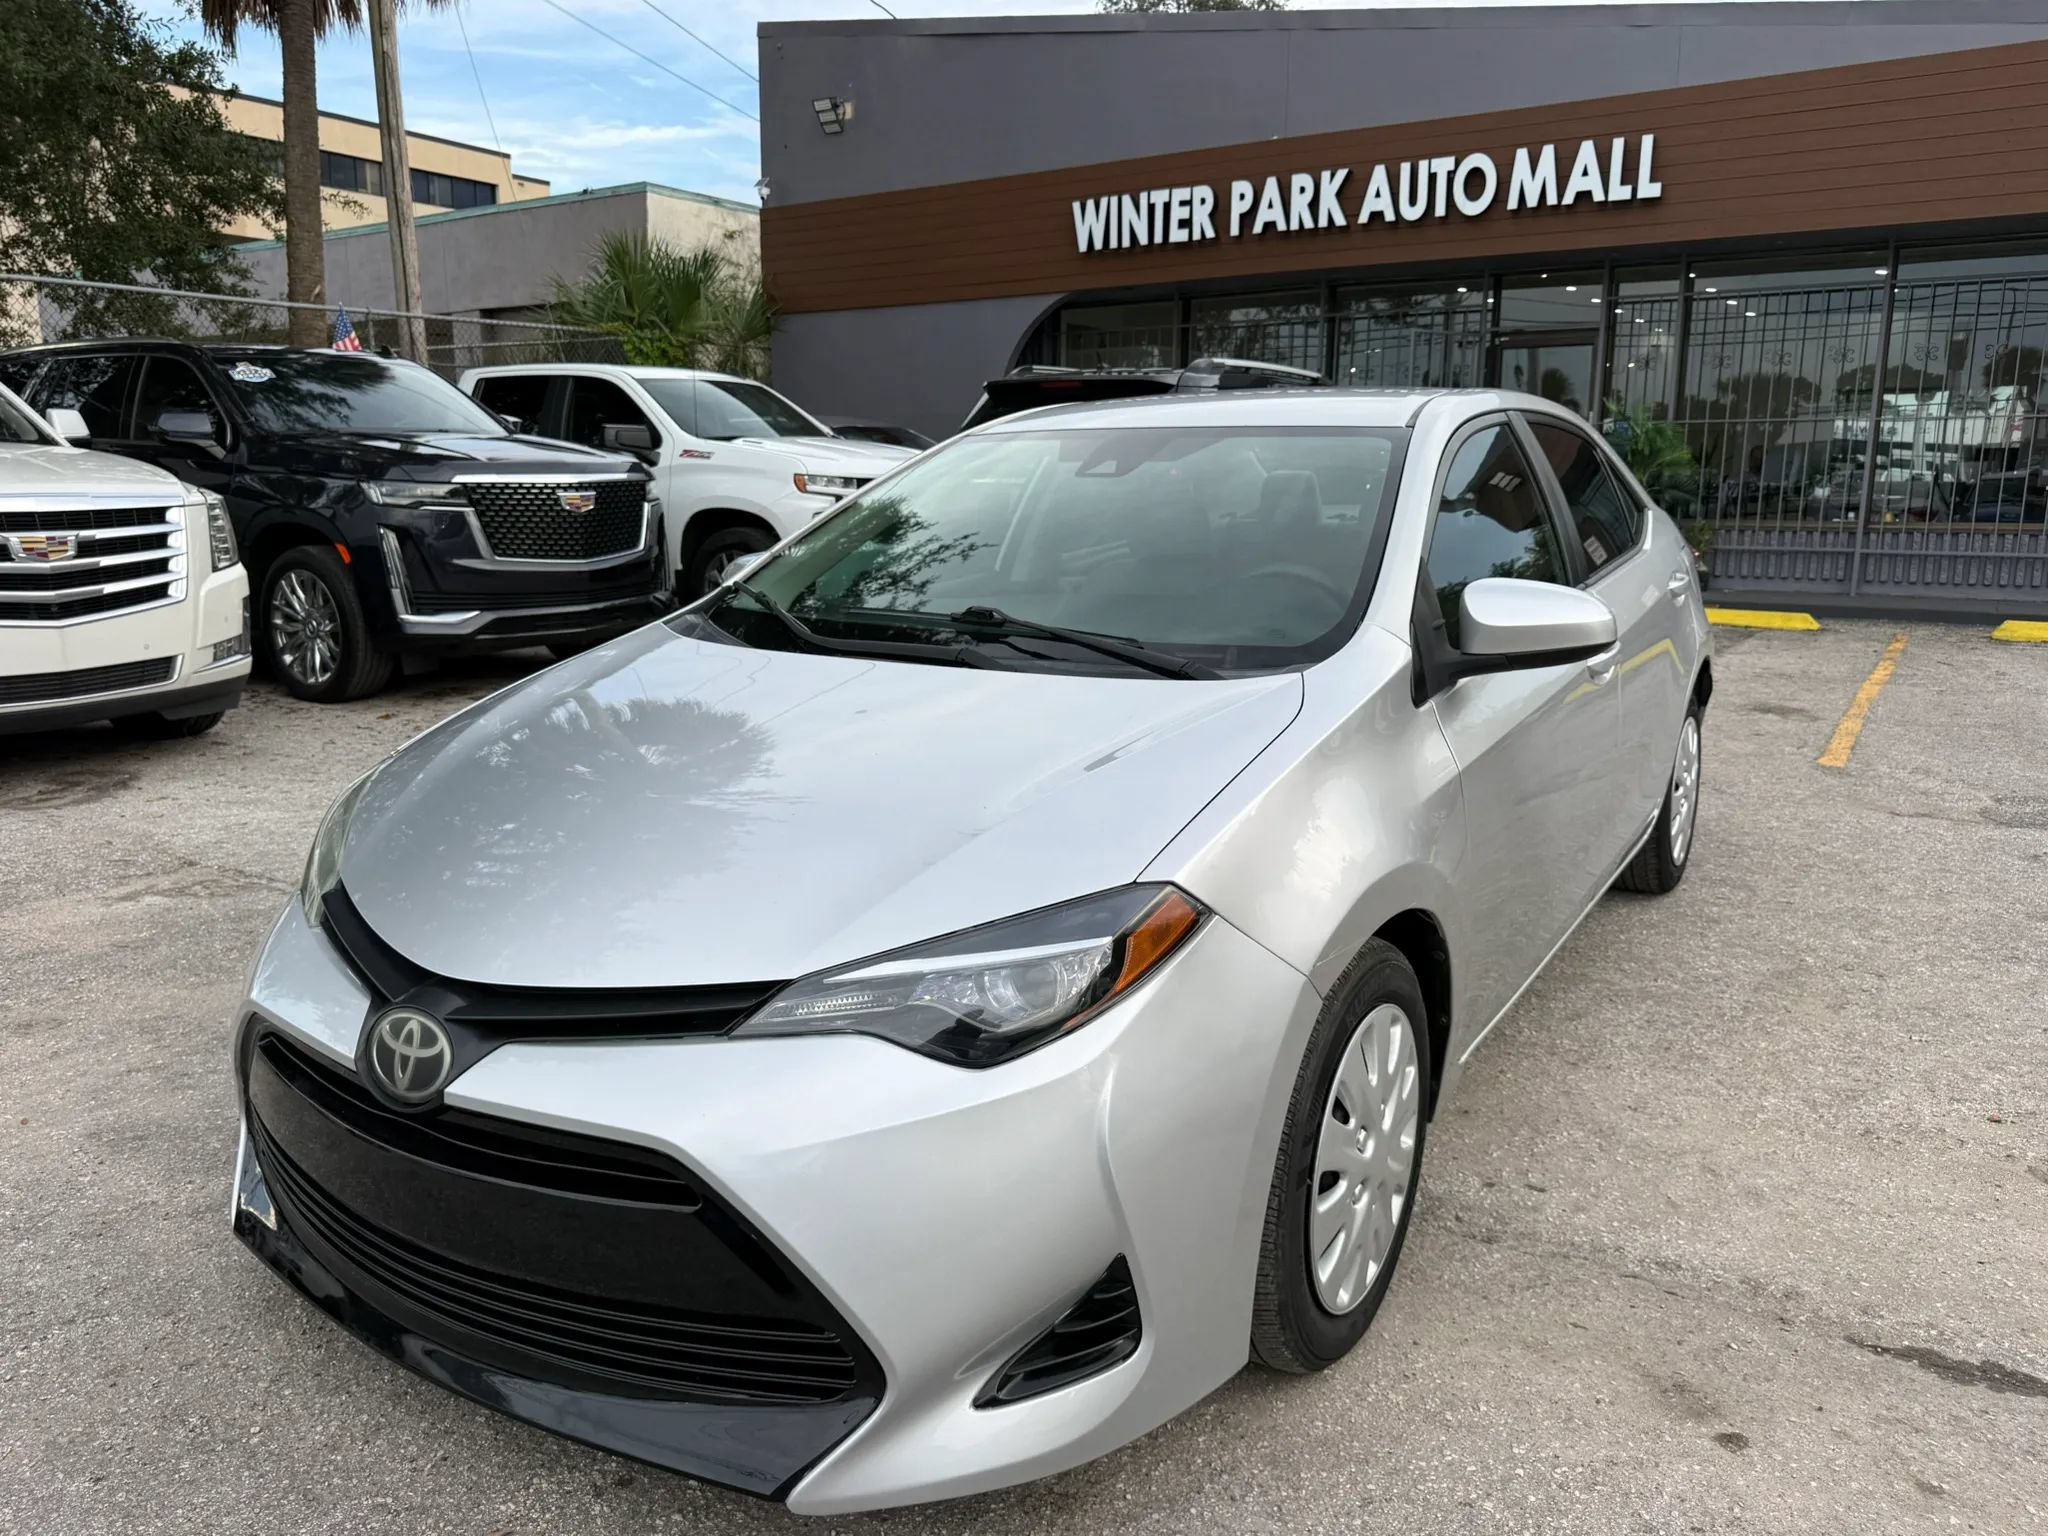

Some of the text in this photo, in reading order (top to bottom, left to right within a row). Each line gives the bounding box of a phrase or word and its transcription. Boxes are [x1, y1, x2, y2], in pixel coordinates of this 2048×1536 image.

[1072, 133, 1662, 253] WINTER PARK AUTO MALL
